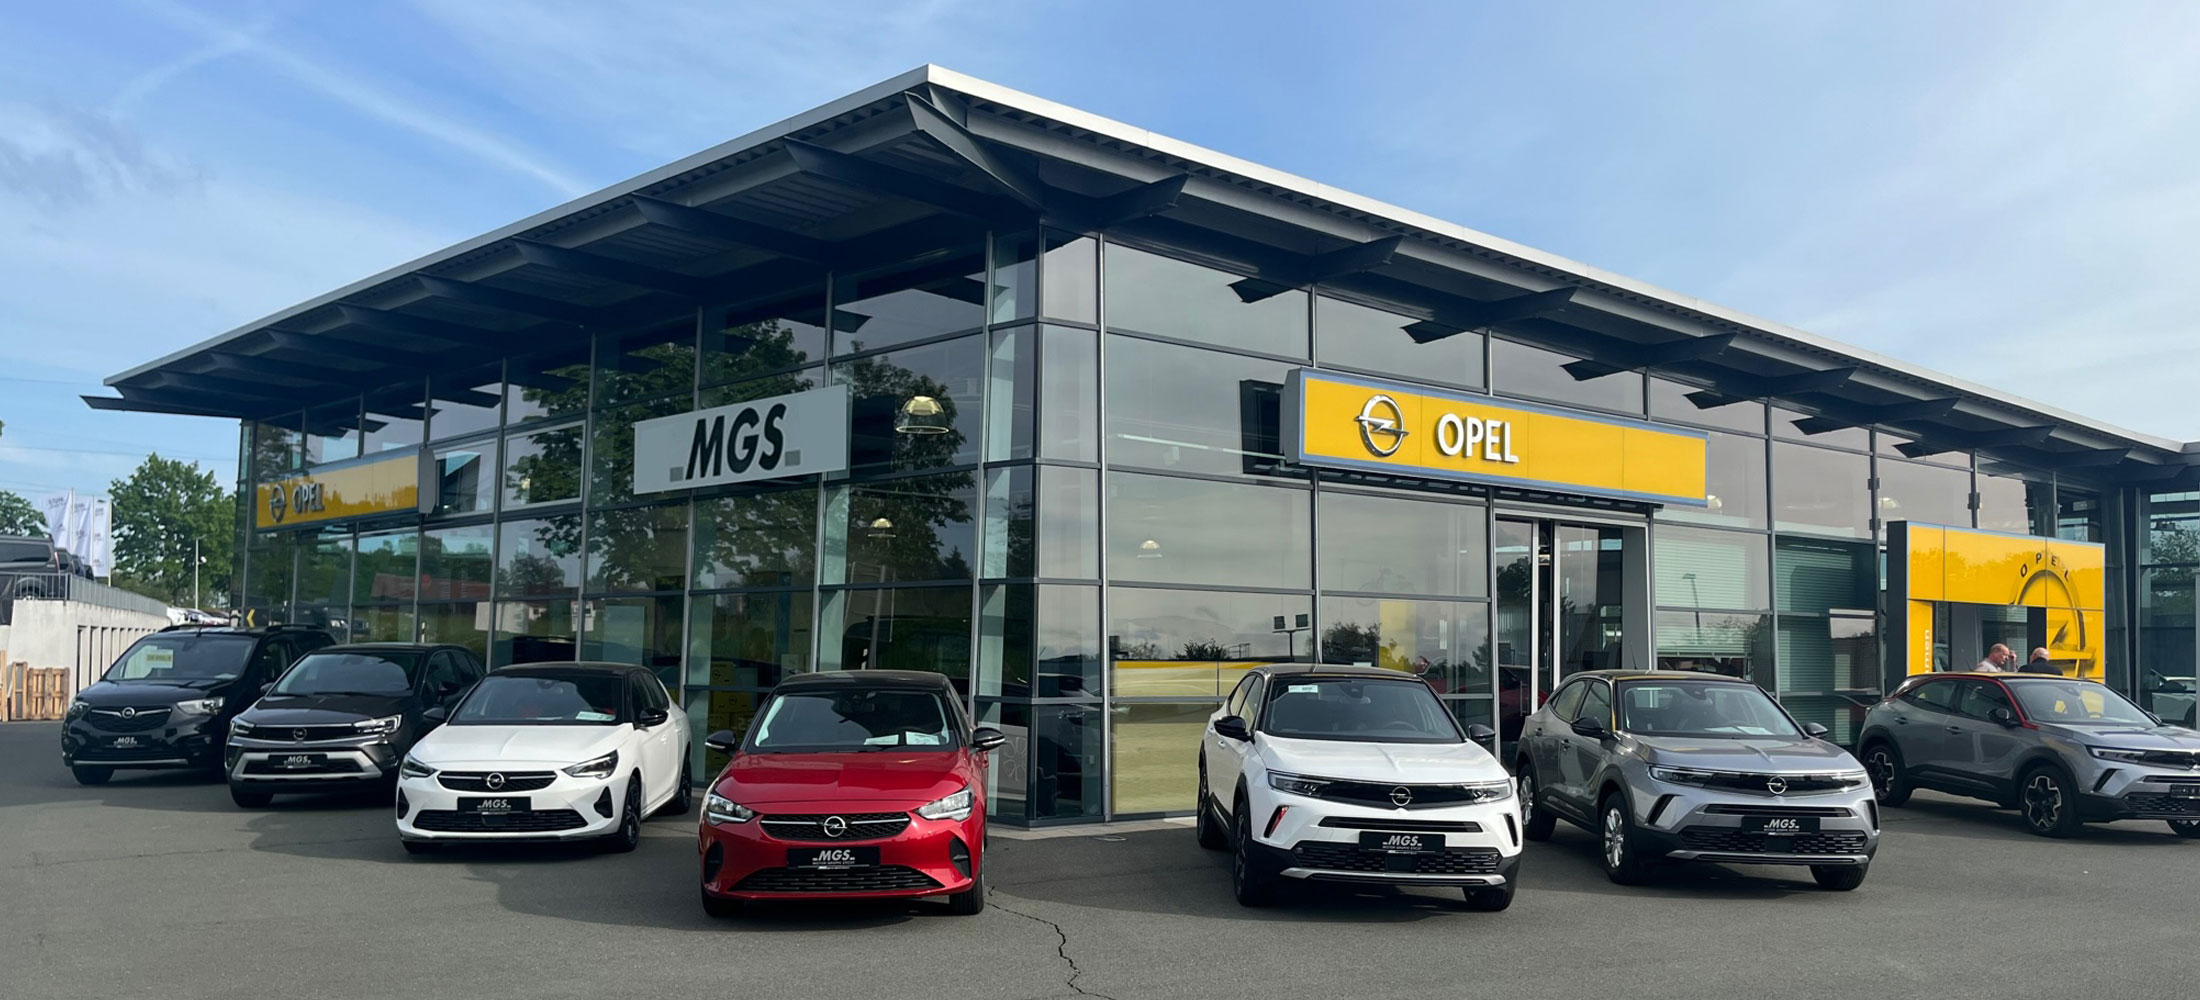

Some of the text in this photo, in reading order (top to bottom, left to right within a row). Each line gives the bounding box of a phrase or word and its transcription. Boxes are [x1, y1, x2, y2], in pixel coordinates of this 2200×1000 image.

[685, 403, 787, 480] MGS
[1436, 413, 1519, 463] OPEL
[292, 483, 325, 514] OPEL
[2020, 553, 2069, 582] OPEL
[287, 755, 308, 764] MGS
[482, 799, 507, 808] MGS
[1769, 819, 1796, 828] MGS
[1388, 835, 1419, 846] MGS
[818, 849, 851, 861] MGS
